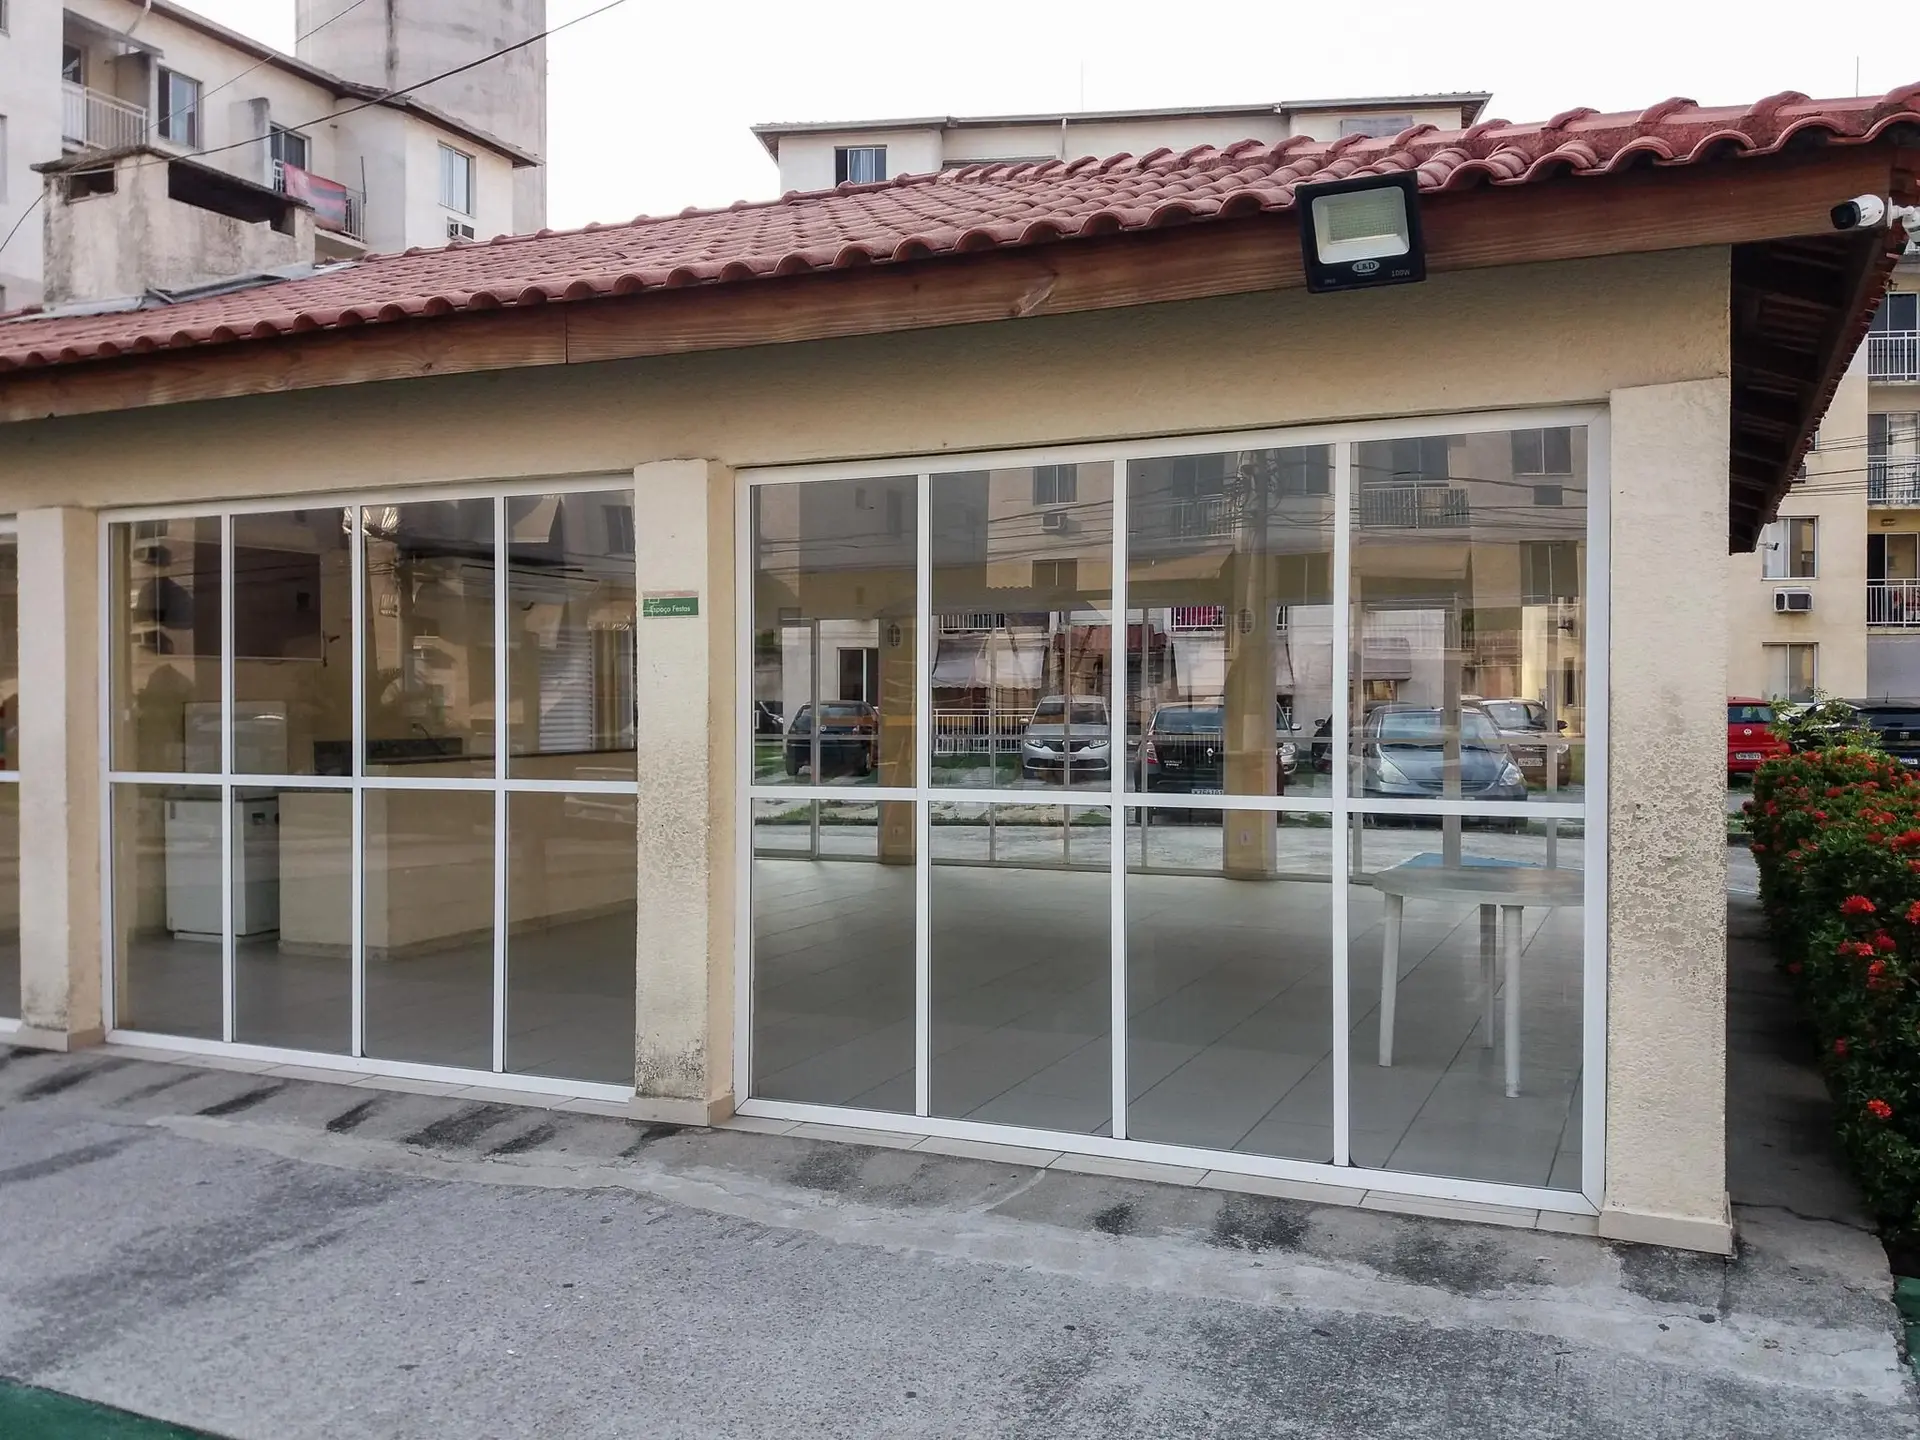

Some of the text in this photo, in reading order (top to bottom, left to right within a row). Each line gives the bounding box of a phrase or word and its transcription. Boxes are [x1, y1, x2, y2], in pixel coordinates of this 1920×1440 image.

[1391, 269, 1410, 277] 100W
[650, 604, 691, 614] Espaço Festas
